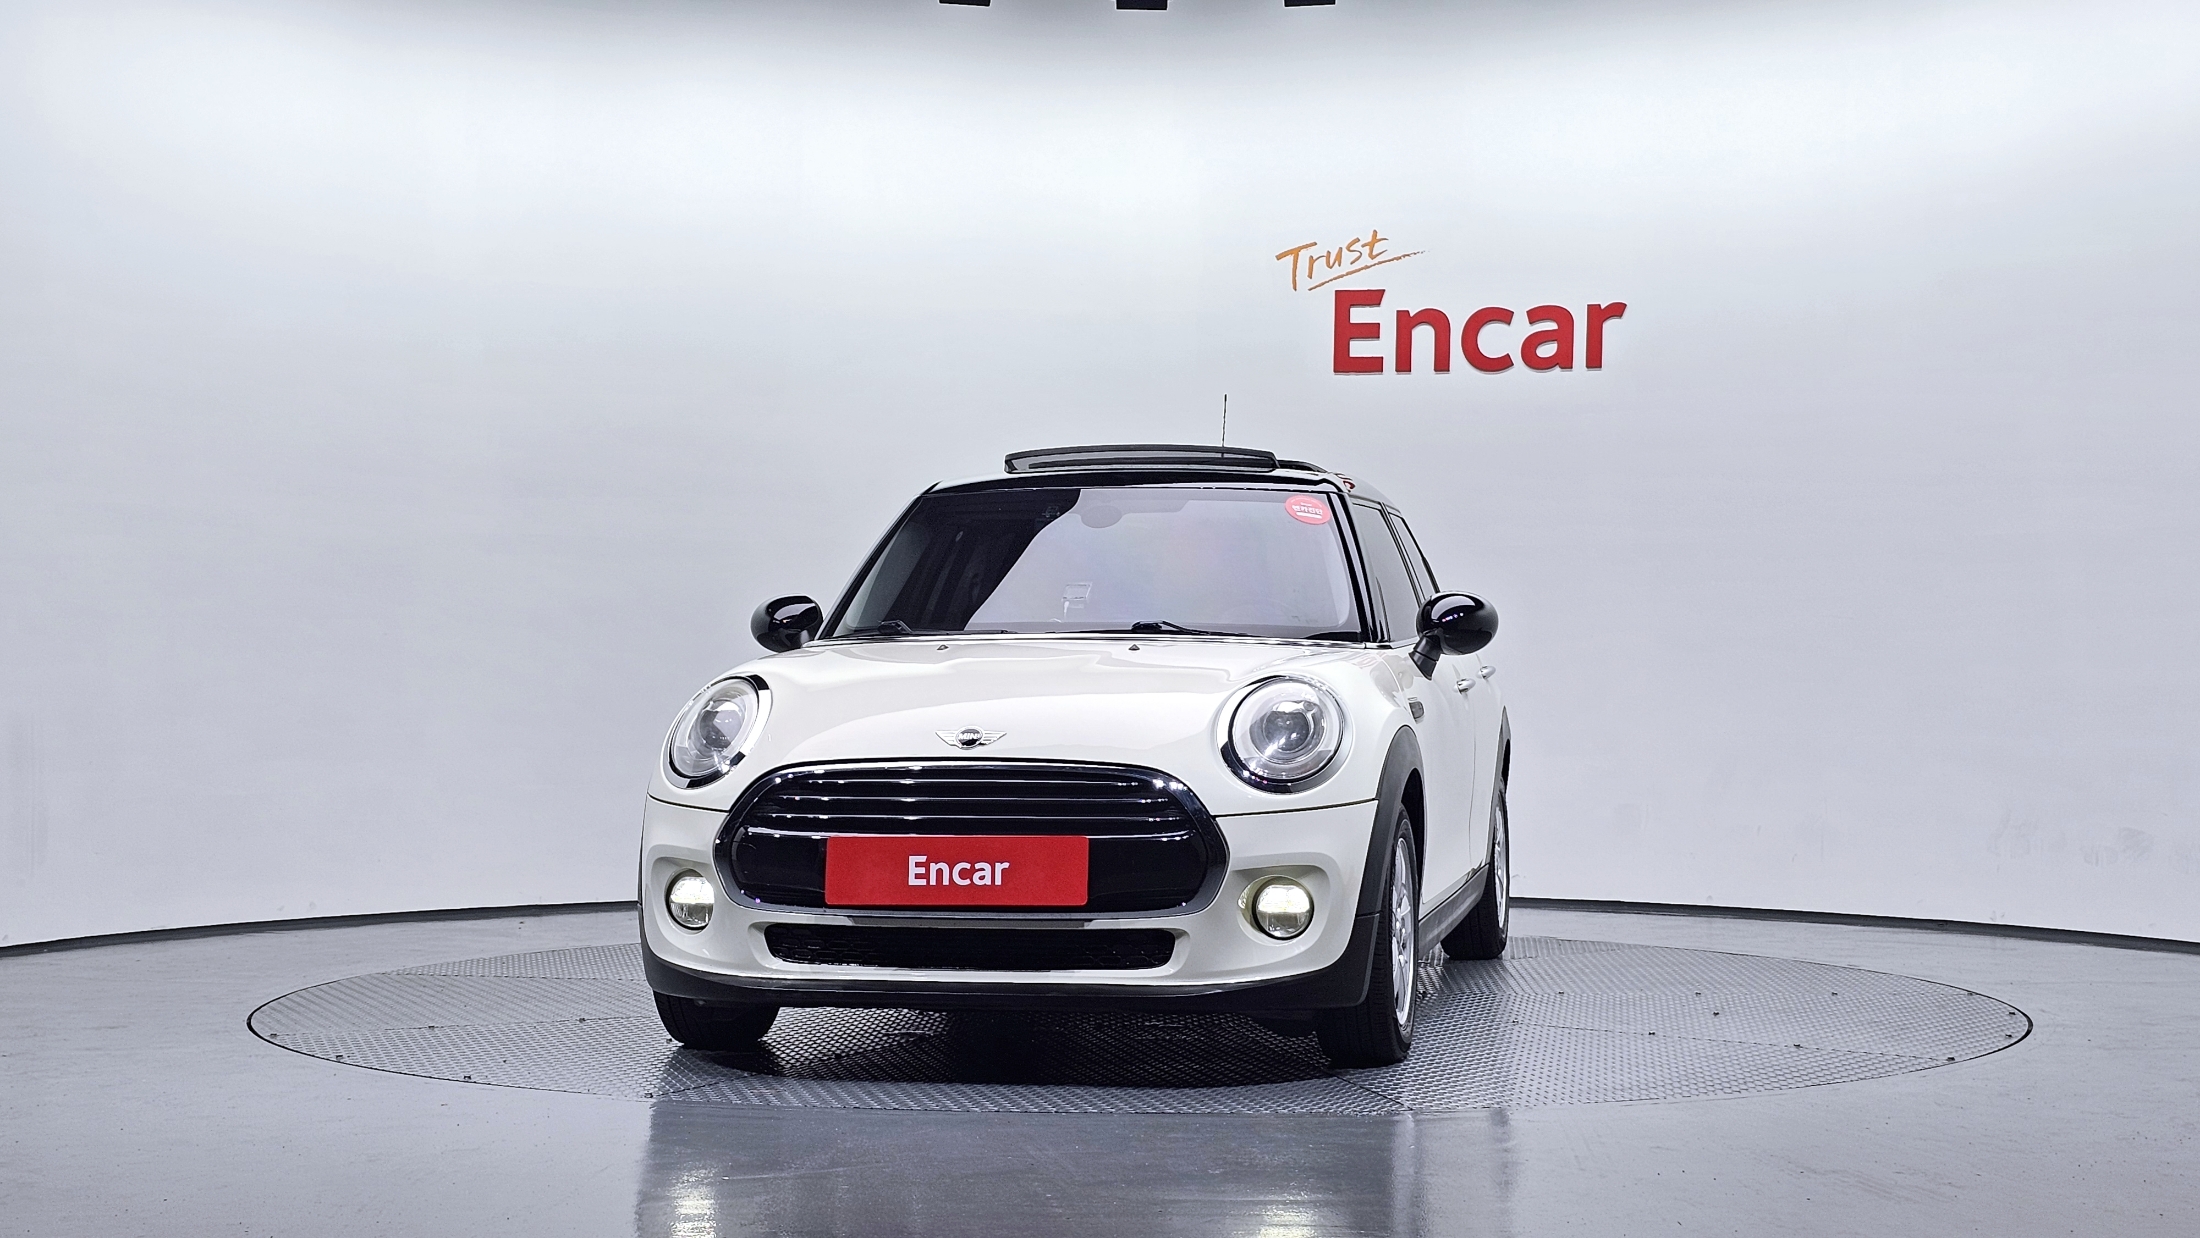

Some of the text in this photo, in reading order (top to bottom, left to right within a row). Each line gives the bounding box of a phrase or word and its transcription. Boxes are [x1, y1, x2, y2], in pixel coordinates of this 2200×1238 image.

[1275, 229, 1390, 292] Trust
[1333, 288, 1628, 374] Encar
[907, 855, 1010, 886] Encar
